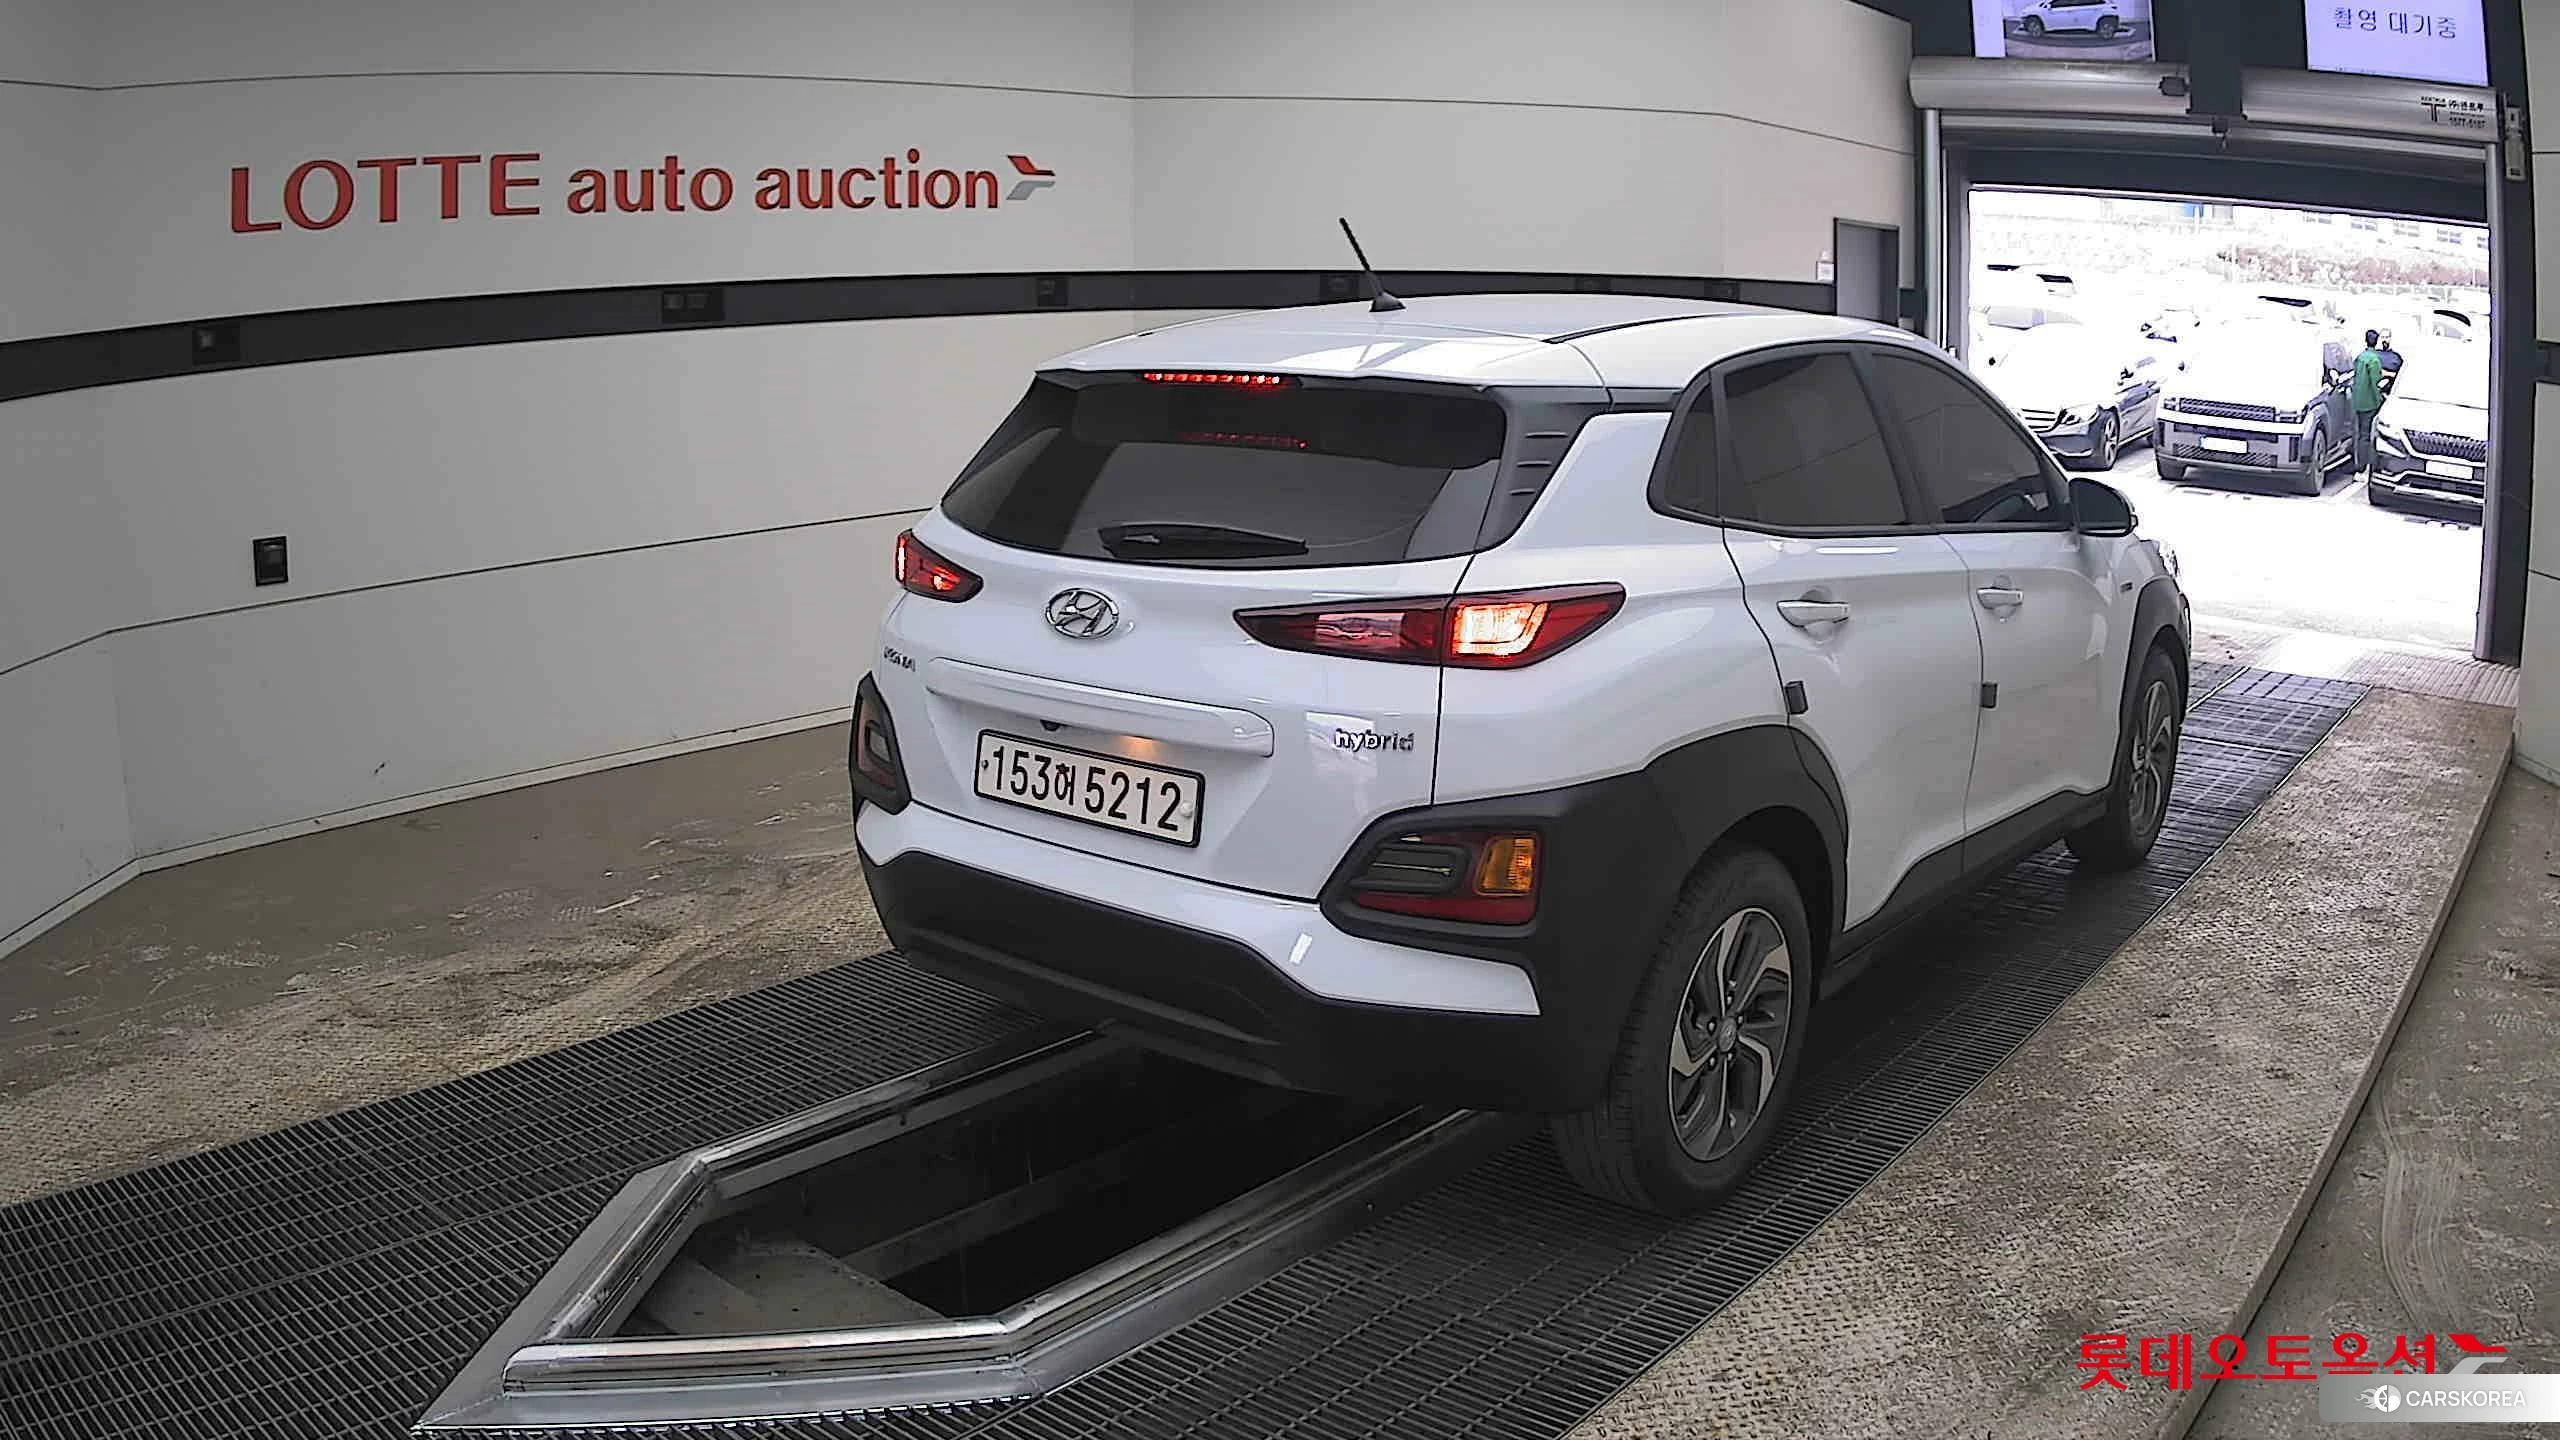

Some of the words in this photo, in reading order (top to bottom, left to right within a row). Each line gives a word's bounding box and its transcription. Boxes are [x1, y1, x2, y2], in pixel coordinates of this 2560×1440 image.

[2388, 11, 2457, 39] 대기중
[231, 153, 540, 233] LOTTE
[567, 155, 734, 214] auto
[754, 148, 999, 209] auction
[1334, 727, 1415, 753] hybrid
[993, 745, 1077, 806] 153허
[1084, 766, 1182, 832] 5212
